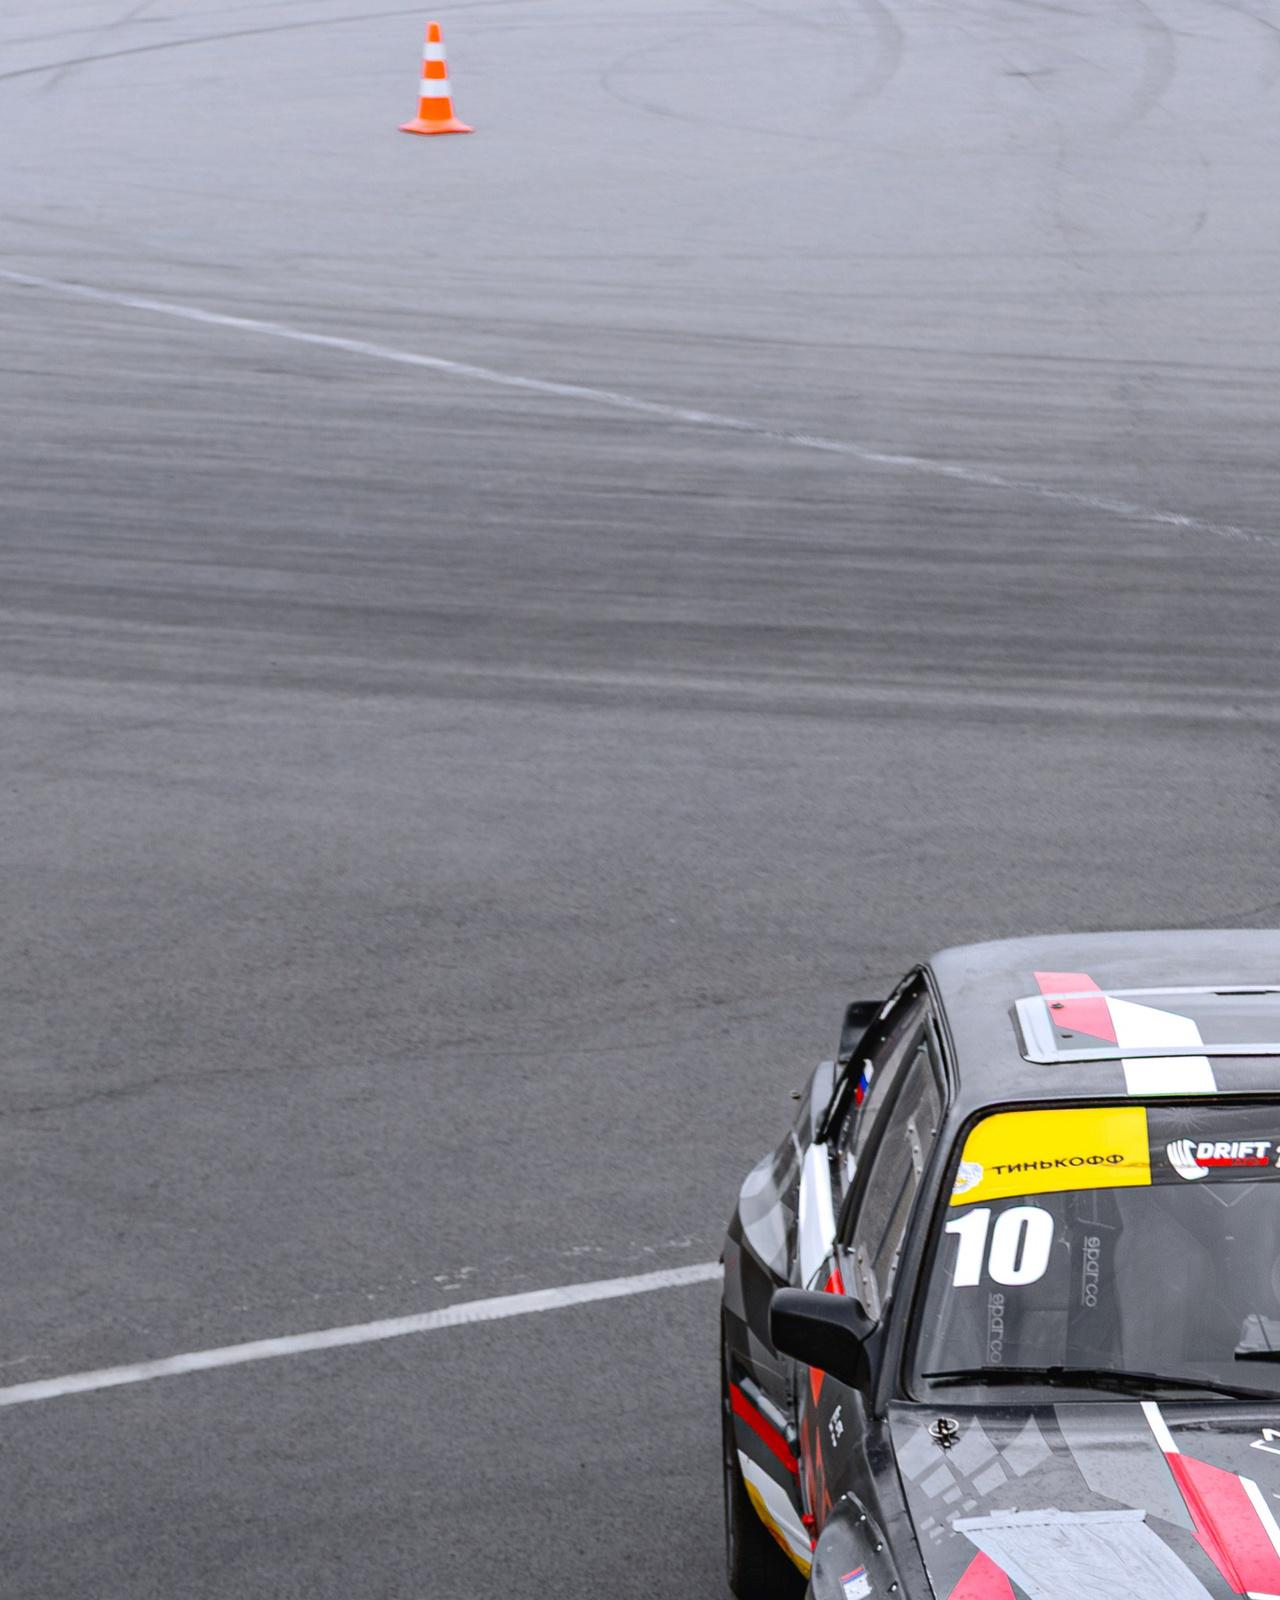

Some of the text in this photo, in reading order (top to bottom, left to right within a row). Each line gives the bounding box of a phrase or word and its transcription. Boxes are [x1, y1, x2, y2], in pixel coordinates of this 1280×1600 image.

[1196, 1141, 1272, 1159] DRIFT
[992, 1154, 1124, 1175] ТИНЬКОФФ
[944, 1205, 1055, 1287] 10
